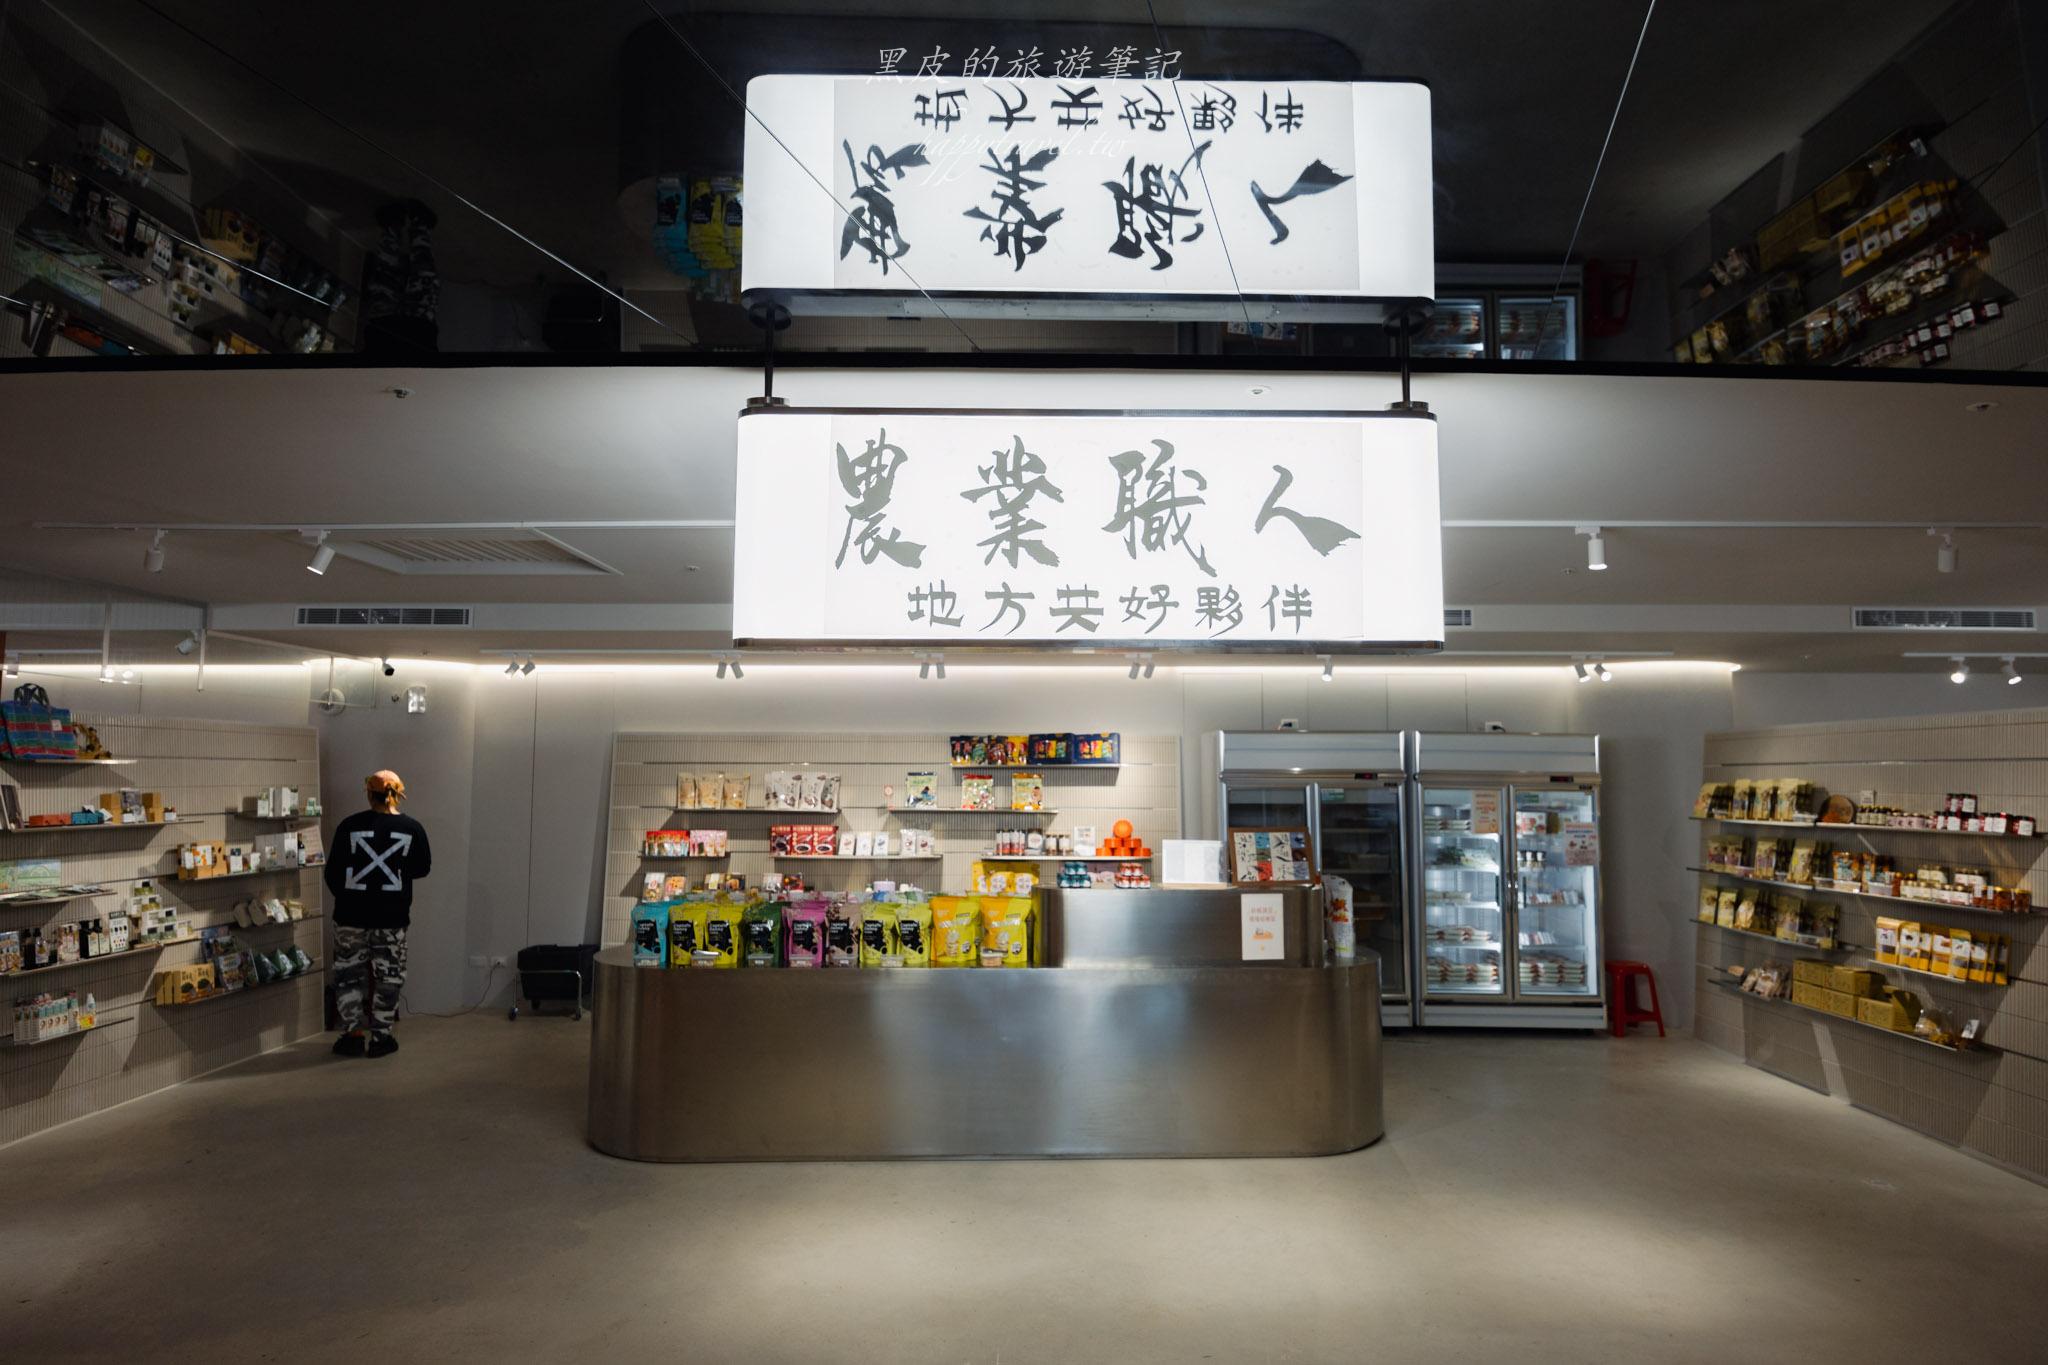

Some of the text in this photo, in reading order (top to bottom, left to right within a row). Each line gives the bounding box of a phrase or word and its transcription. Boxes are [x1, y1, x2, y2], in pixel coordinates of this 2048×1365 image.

[835, 427, 1362, 578] 農業職人
[908, 578, 1313, 639] 地方共好夥伴
